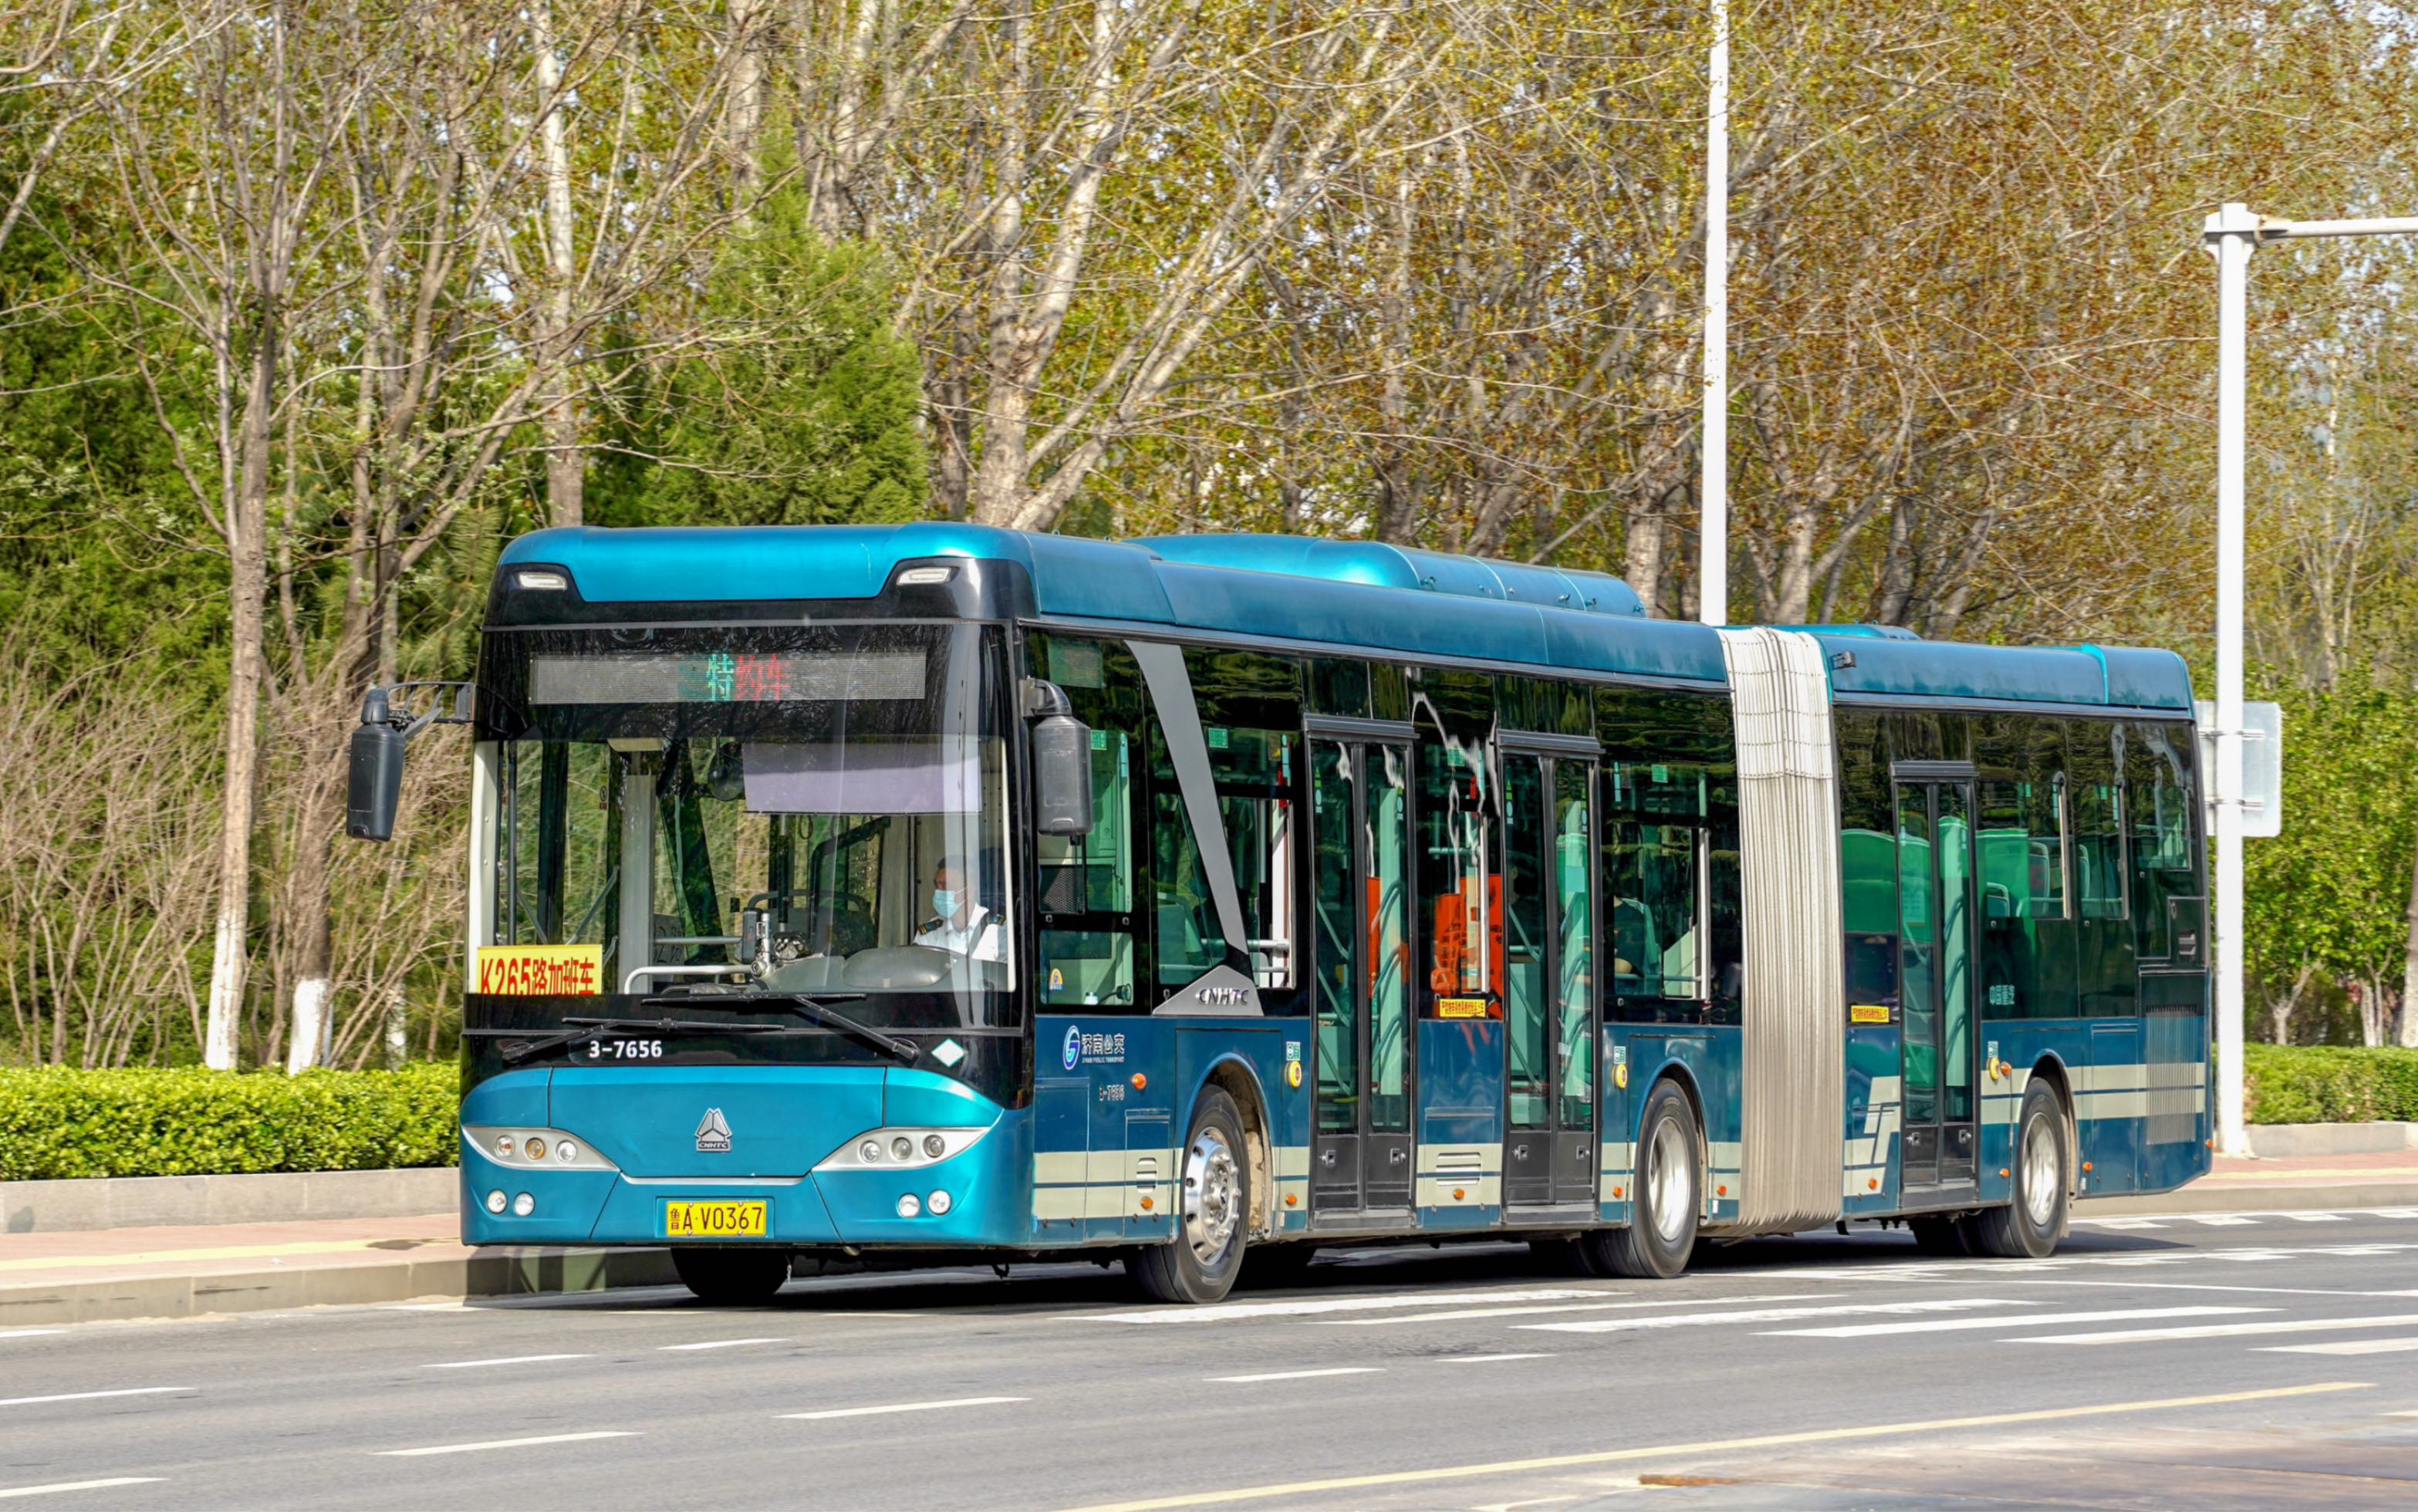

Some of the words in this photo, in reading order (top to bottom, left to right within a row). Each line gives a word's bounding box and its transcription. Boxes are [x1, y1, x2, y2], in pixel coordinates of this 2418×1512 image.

[481, 957, 595, 995] K265路加班车
[1196, 987, 1248, 1004] CNHTC
[589, 1040, 662, 1058] 3-7656
[1082, 1034, 1125, 1055] 济南公交
